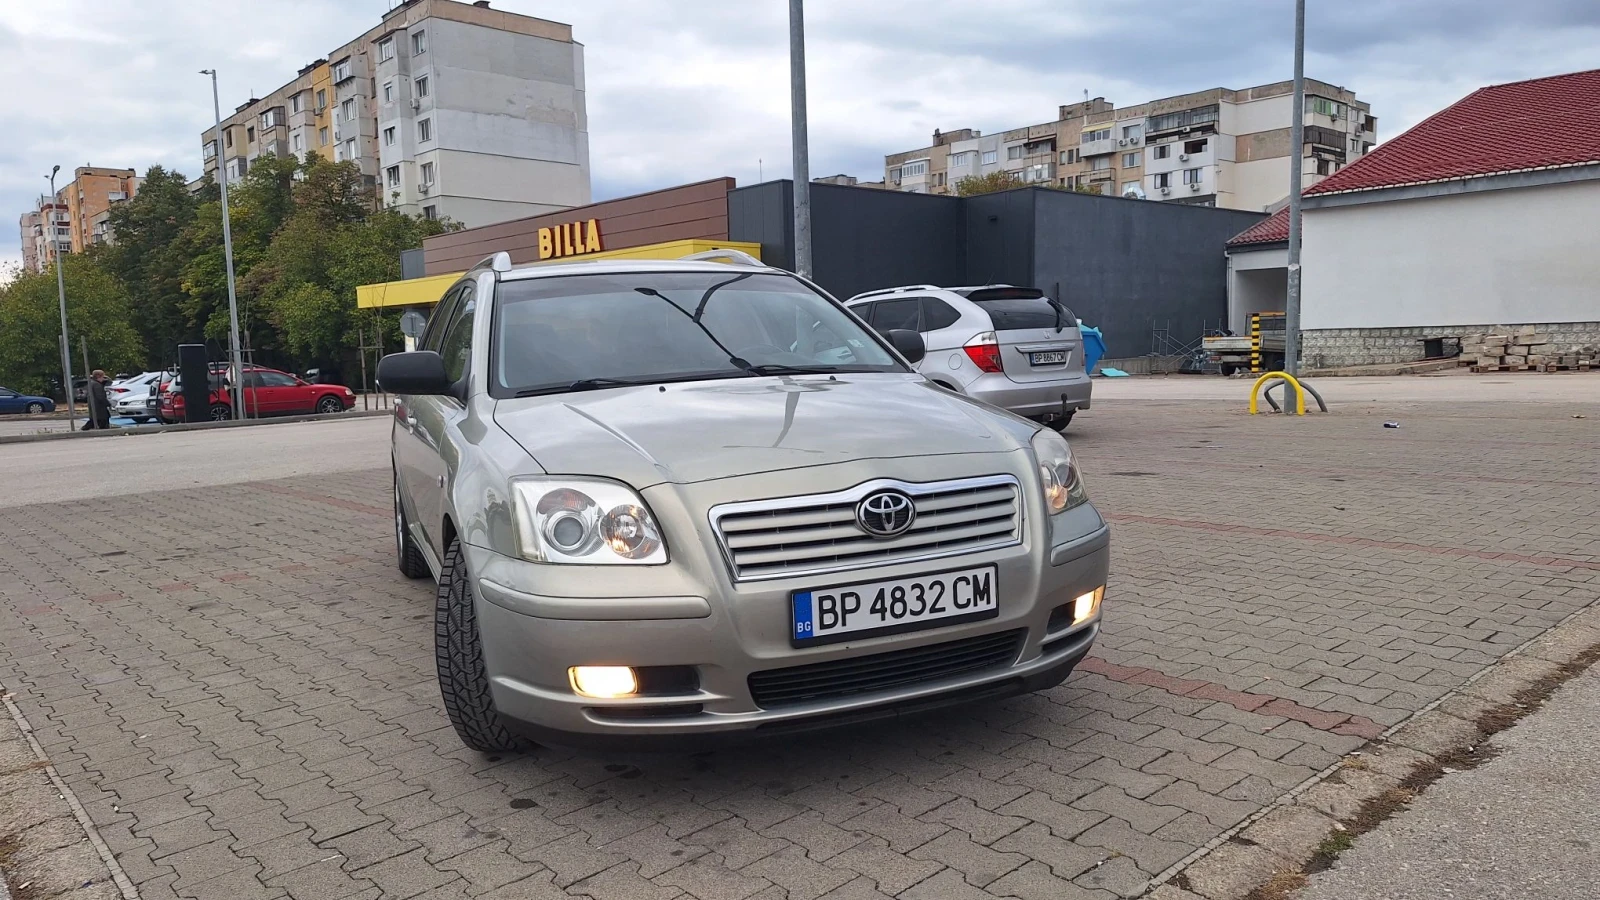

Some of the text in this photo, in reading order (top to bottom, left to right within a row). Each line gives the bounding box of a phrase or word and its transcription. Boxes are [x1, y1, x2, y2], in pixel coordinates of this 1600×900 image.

[538, 218, 602, 259] BILLA
[1035, 353, 1043, 363] BP
[818, 572, 991, 630] BP 4832 CM
[797, 621, 811, 633] BG
